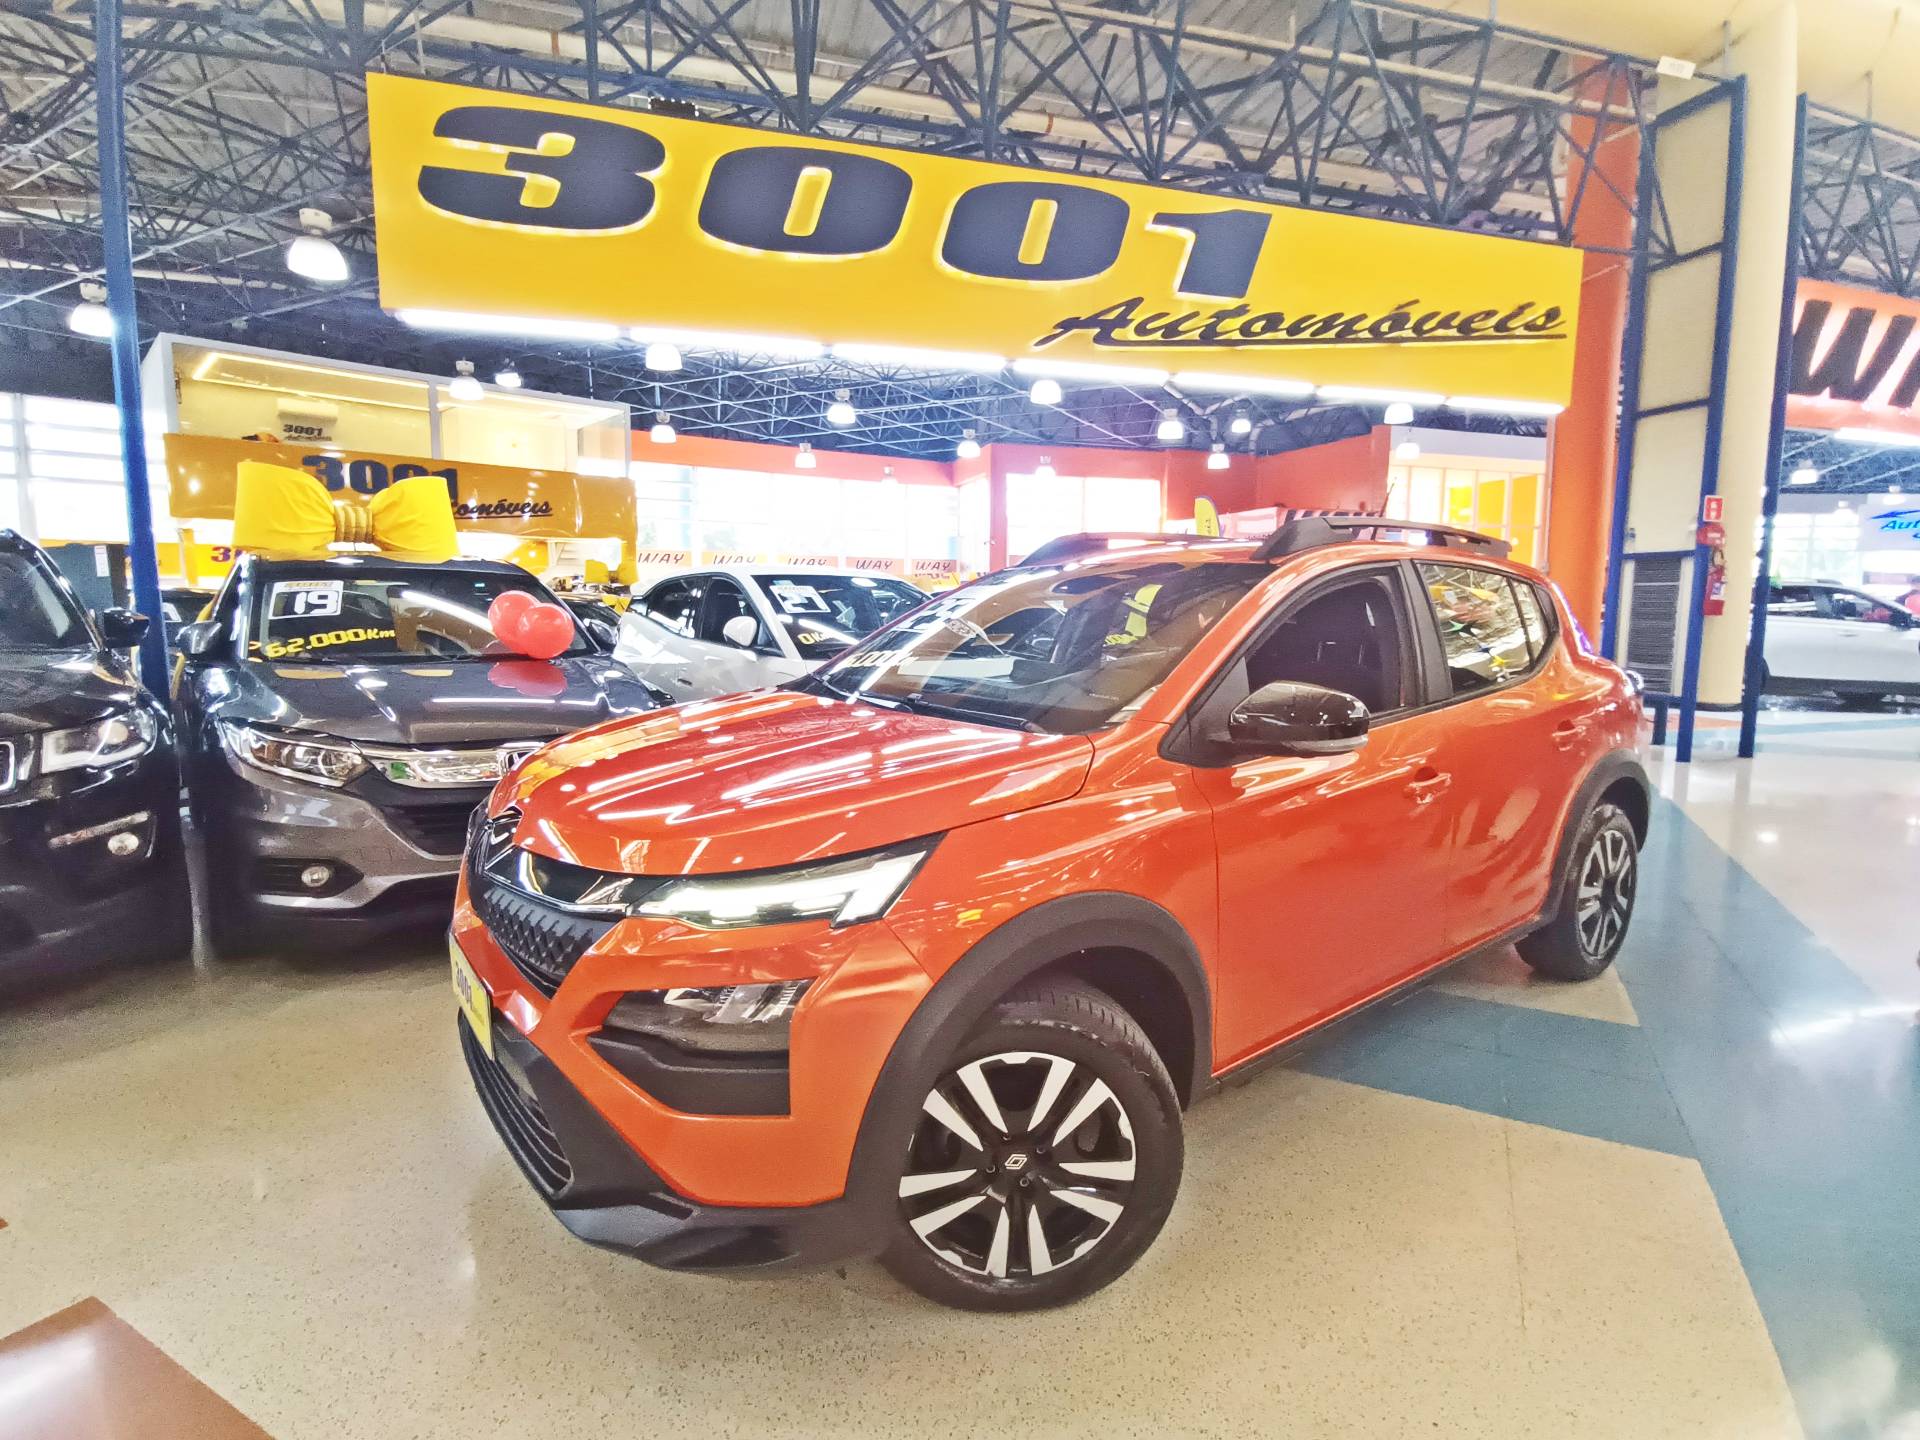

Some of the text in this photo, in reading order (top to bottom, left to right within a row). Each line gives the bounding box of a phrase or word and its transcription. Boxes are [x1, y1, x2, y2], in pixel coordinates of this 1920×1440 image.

[418, 105, 1273, 299] 3001
[1034, 296, 1567, 346] Automóveis
[638, 553, 684, 564] WAY
[855, 559, 893, 570] WAY
[915, 561, 951, 571] WAY
[294, 590, 340, 614] 19
[265, 628, 396, 658] 62.000Km
